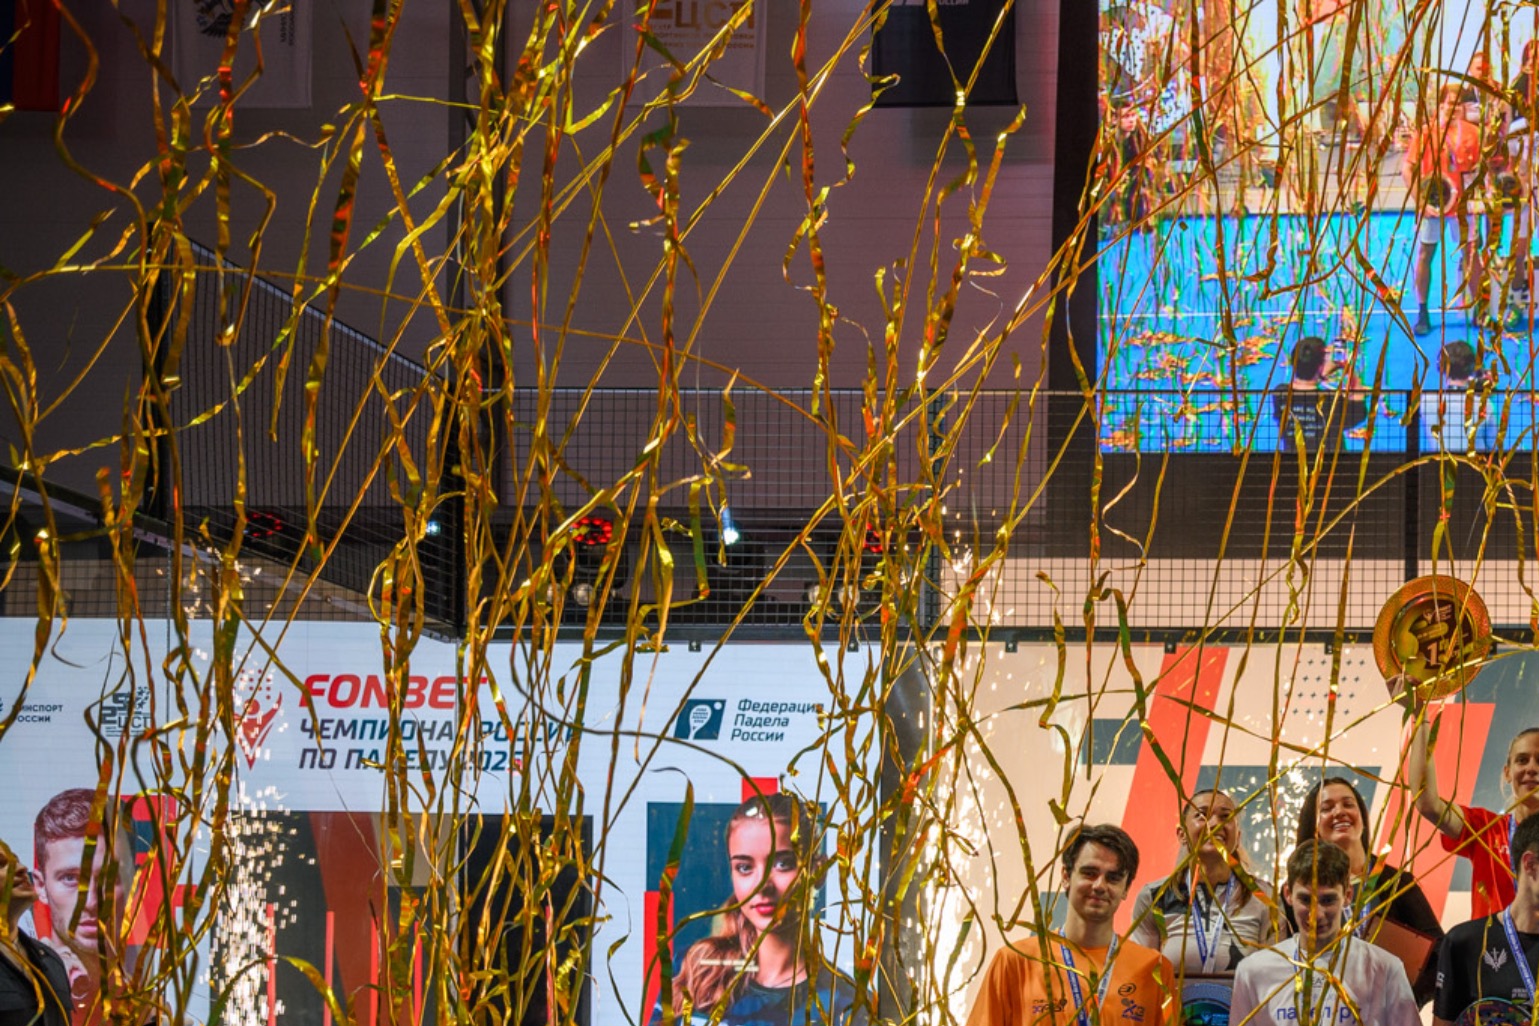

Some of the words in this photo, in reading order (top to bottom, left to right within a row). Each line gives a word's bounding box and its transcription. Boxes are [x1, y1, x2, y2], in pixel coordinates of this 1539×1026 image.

[14, 704, 63, 712] ИНСПОРТ
[14, 715, 51, 723] ОССИИ
[734, 714, 790, 728] Падела
[300, 719, 474, 741] ЧЕМПИОНА
[731, 728, 784, 742] России
[299, 749, 336, 769] ПО
[345, 749, 454, 771] ПАЕЛУ
